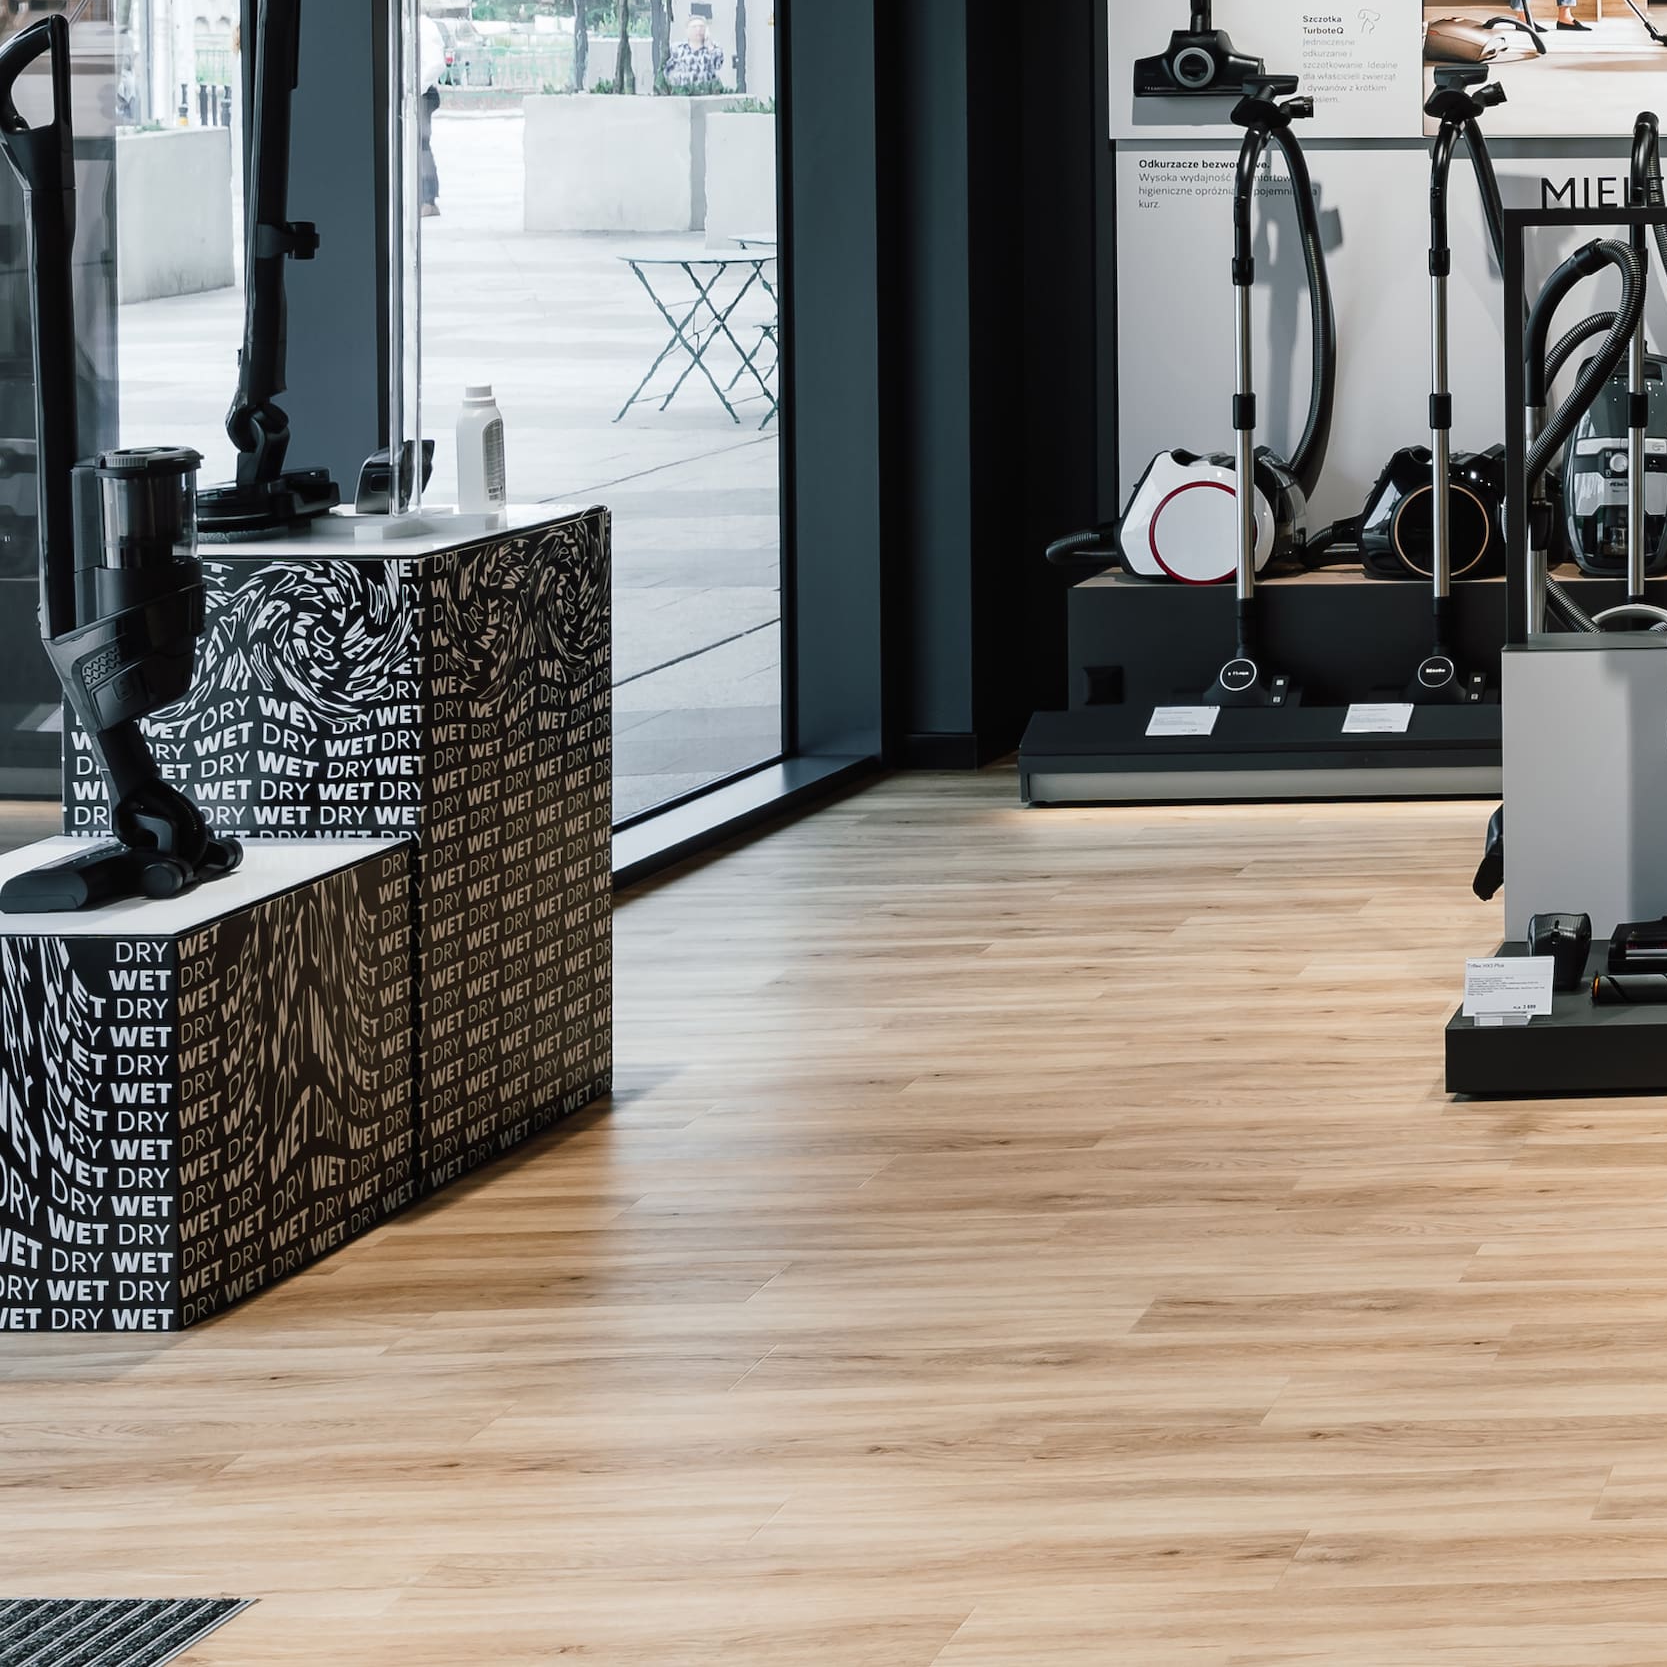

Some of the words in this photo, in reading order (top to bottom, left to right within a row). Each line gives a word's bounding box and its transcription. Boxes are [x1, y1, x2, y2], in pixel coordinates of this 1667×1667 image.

[1303, 15, 1342, 23] Szczotka
[1303, 27, 1344, 35] TurboteQ
[1303, 50, 1347, 58] odkurzanie
[1303, 73, 1315, 81] dla
[1318, 73, 1360, 81] właścicieli
[1362, 74, 1396, 82] zwierząt
[1307, 85, 1347, 93] dywanów
[1356, 84, 1387, 92] krótkim
[1139, 160, 1199, 169] Odkurzacze
[1139, 174, 1177, 184] Wysoka
[1181, 173, 1232, 185] wydajność
[1139, 186, 1193, 197] higieniczne
[1139, 200, 1160, 209] kurz.
[194, 722, 254, 757] WET
[325, 735, 376, 758] WET
[432, 724, 467, 744] WET
[201, 750, 250, 779] DRY
[327, 758, 377, 780] DRY
[433, 746, 464, 770] DRY
[260, 783, 310, 801] DRY
[380, 782, 424, 801] DRY
[320, 806, 368, 825] DRY
[431, 960, 466, 991] WET
[500, 930, 533, 960] WET
[564, 902, 592, 930] WET
[109, 969, 172, 991] WET
[181, 952, 217, 989] DRY
[109, 1026, 173, 1048] WET
[110, 1082, 173, 1104] WET
[181, 1068, 217, 1101] DRY
[110, 1139, 173, 1161] WET
[110, 1195, 173, 1217] WET
[52, 1252, 103, 1273] DRY
[47, 1280, 109, 1301] WET
[51, 1309, 103, 1329] DRY
[112, 1309, 174, 1329] WET
